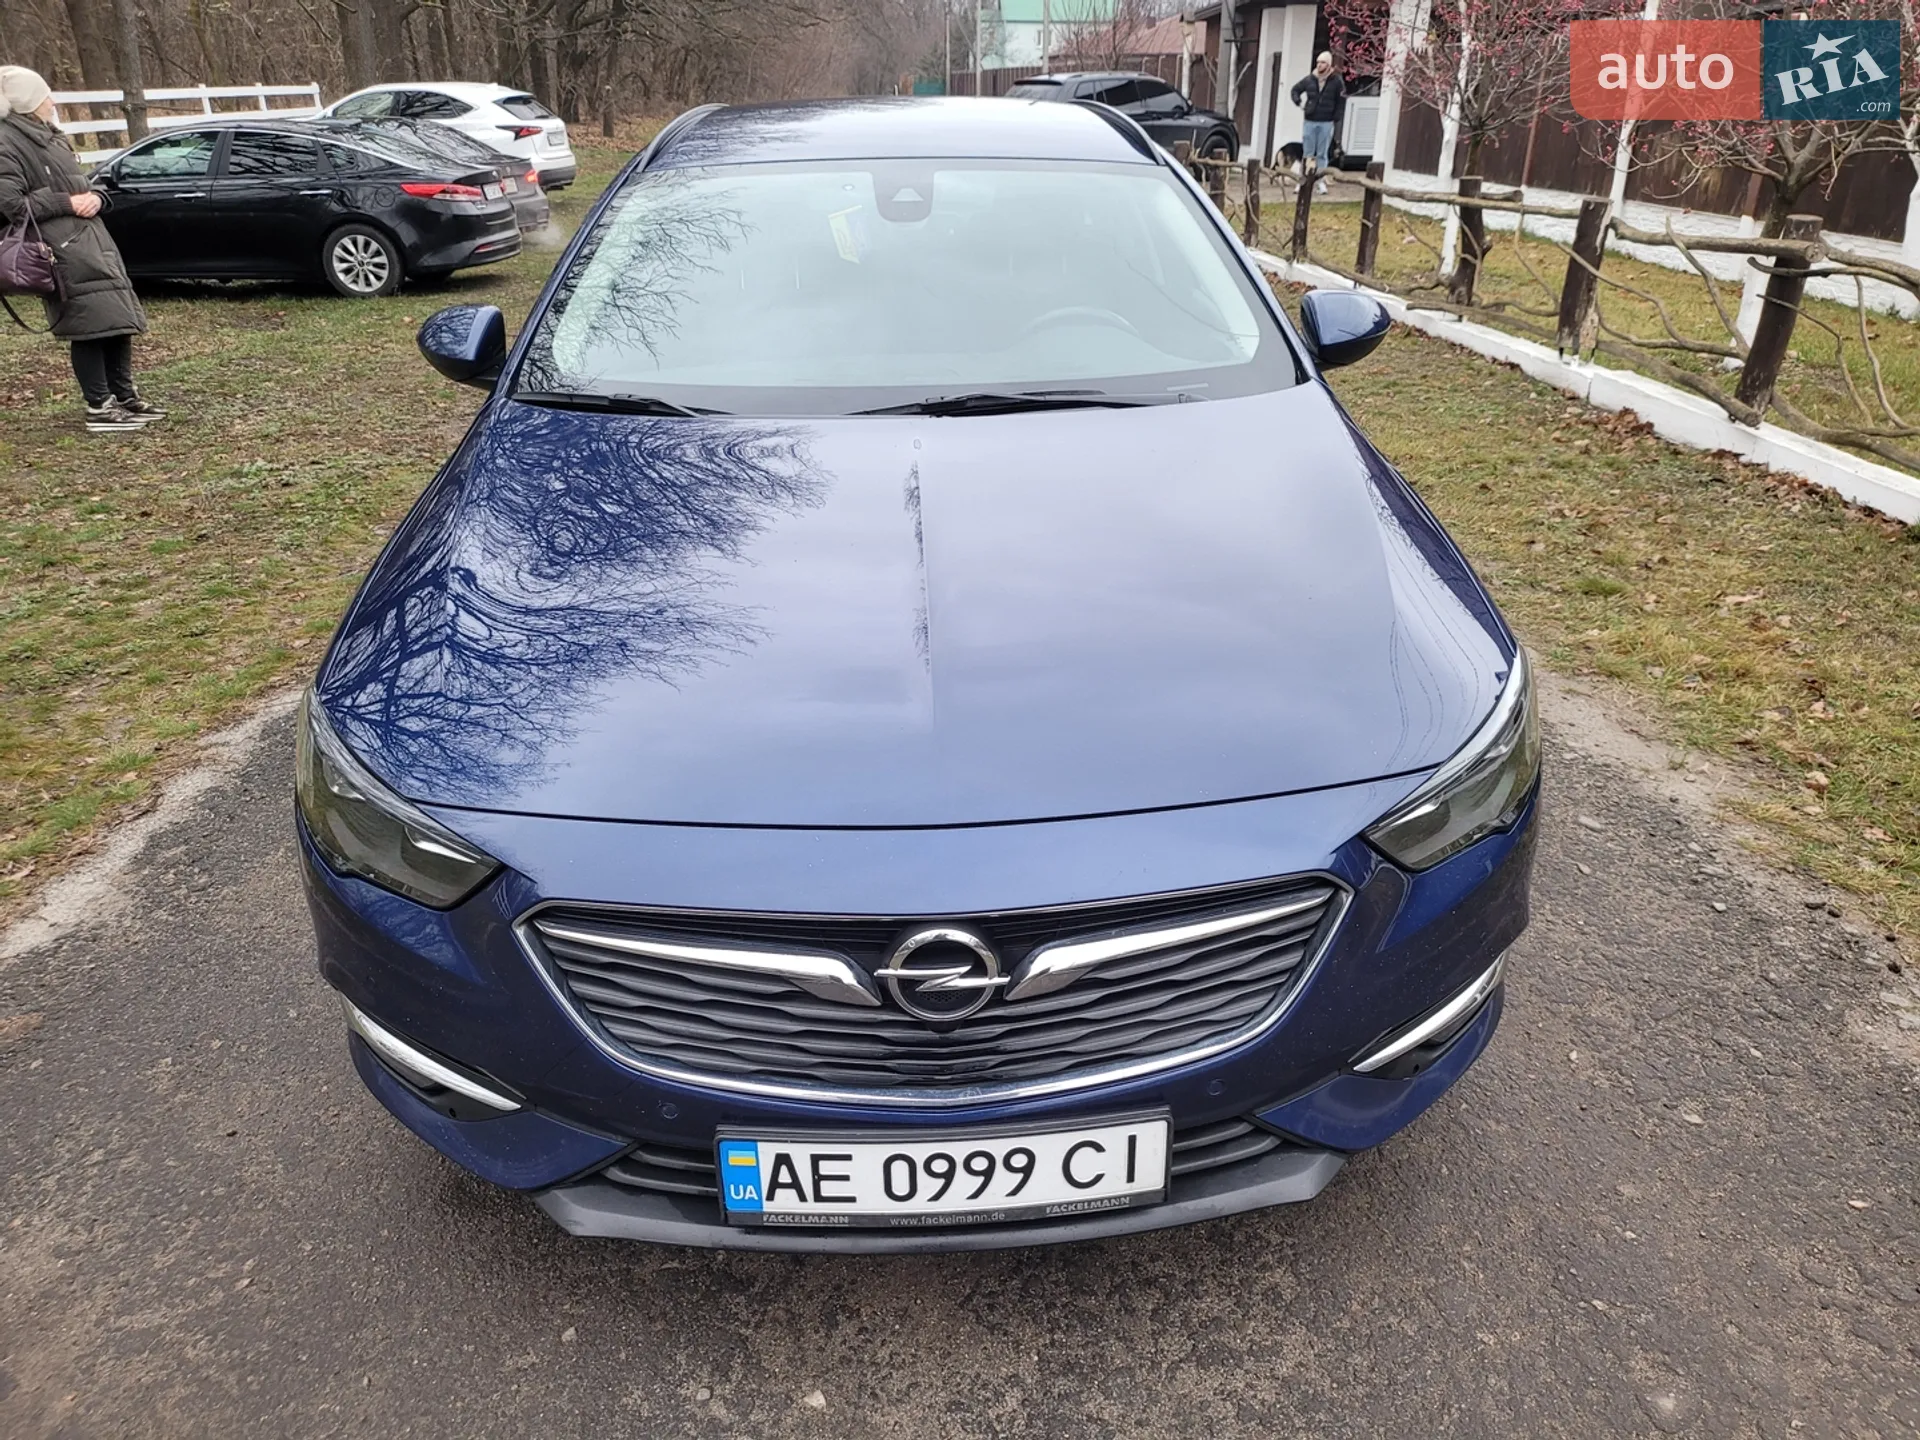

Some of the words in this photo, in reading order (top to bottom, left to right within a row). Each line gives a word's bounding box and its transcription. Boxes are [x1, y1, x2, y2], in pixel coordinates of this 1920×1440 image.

[765, 1152, 857, 1203] AE
[882, 1146, 1036, 1202] 0999
[1061, 1133, 1136, 1189] CI
[730, 1184, 758, 1201] UA
[1045, 1196, 1130, 1215] FACKELMANN
[762, 1214, 849, 1225] FACKELMANN
[889, 1211, 1005, 1226] www.fackelmann.de
